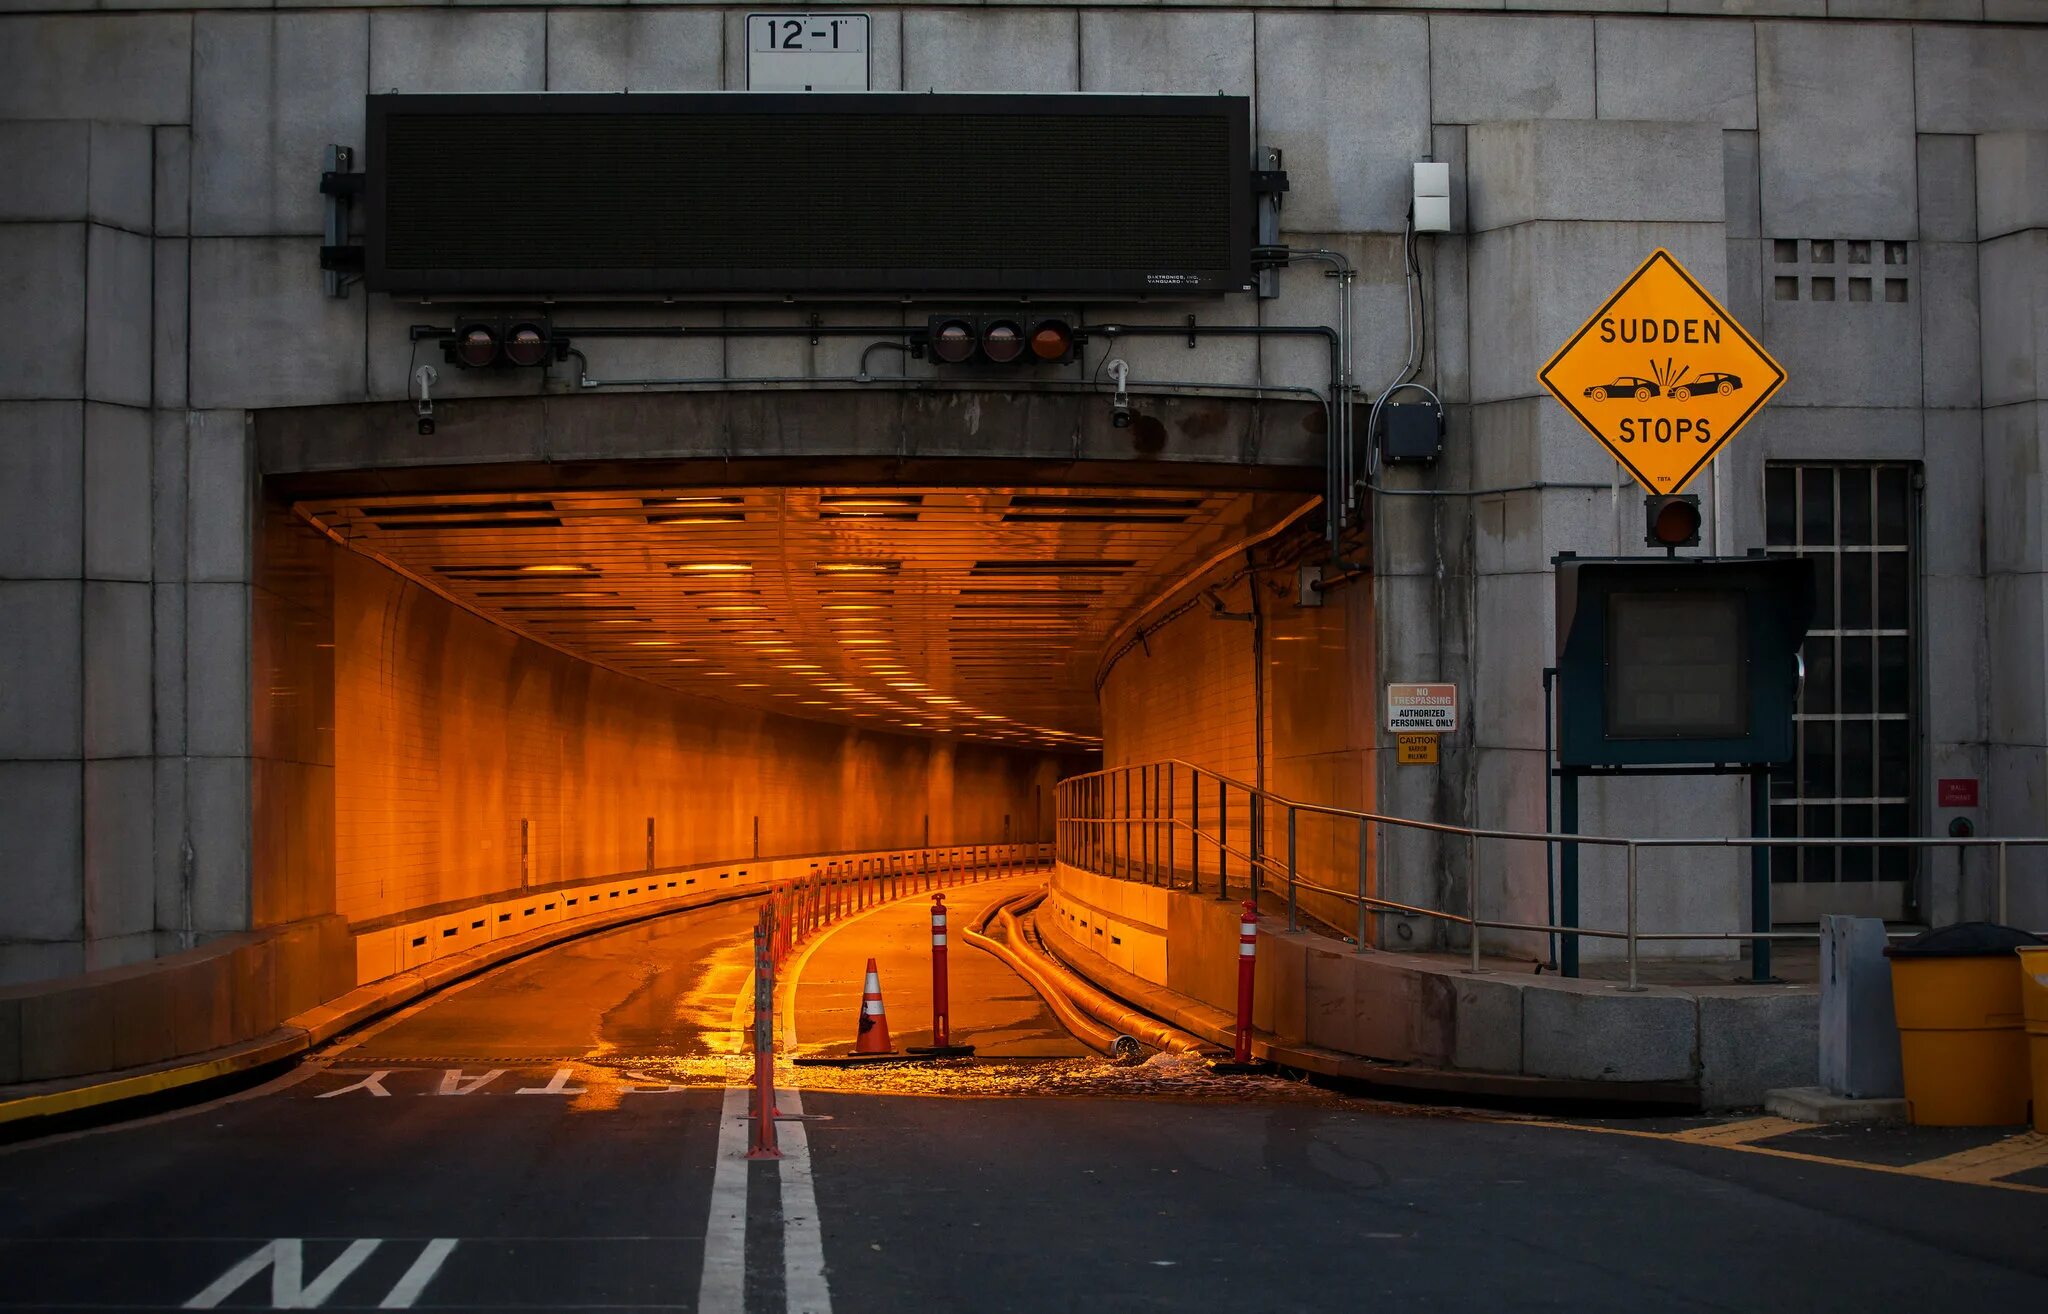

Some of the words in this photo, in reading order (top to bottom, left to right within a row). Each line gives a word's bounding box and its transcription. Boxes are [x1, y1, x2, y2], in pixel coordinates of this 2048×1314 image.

[1600, 318, 1721, 344] SUDDEN
[1619, 418, 1711, 443] STOPS
[1416, 687, 1429, 696] NO
[1394, 696, 1451, 705] TRESPASSING
[1399, 709, 1446, 717] AUTHORIZED
[1391, 719, 1434, 727] PERSONNEL
[1435, 719, 1454, 727] ONLY
[1400, 736, 1437, 744] CAUTION
[314, 1068, 688, 1098] STAY
[181, 1238, 459, 1309] IN
